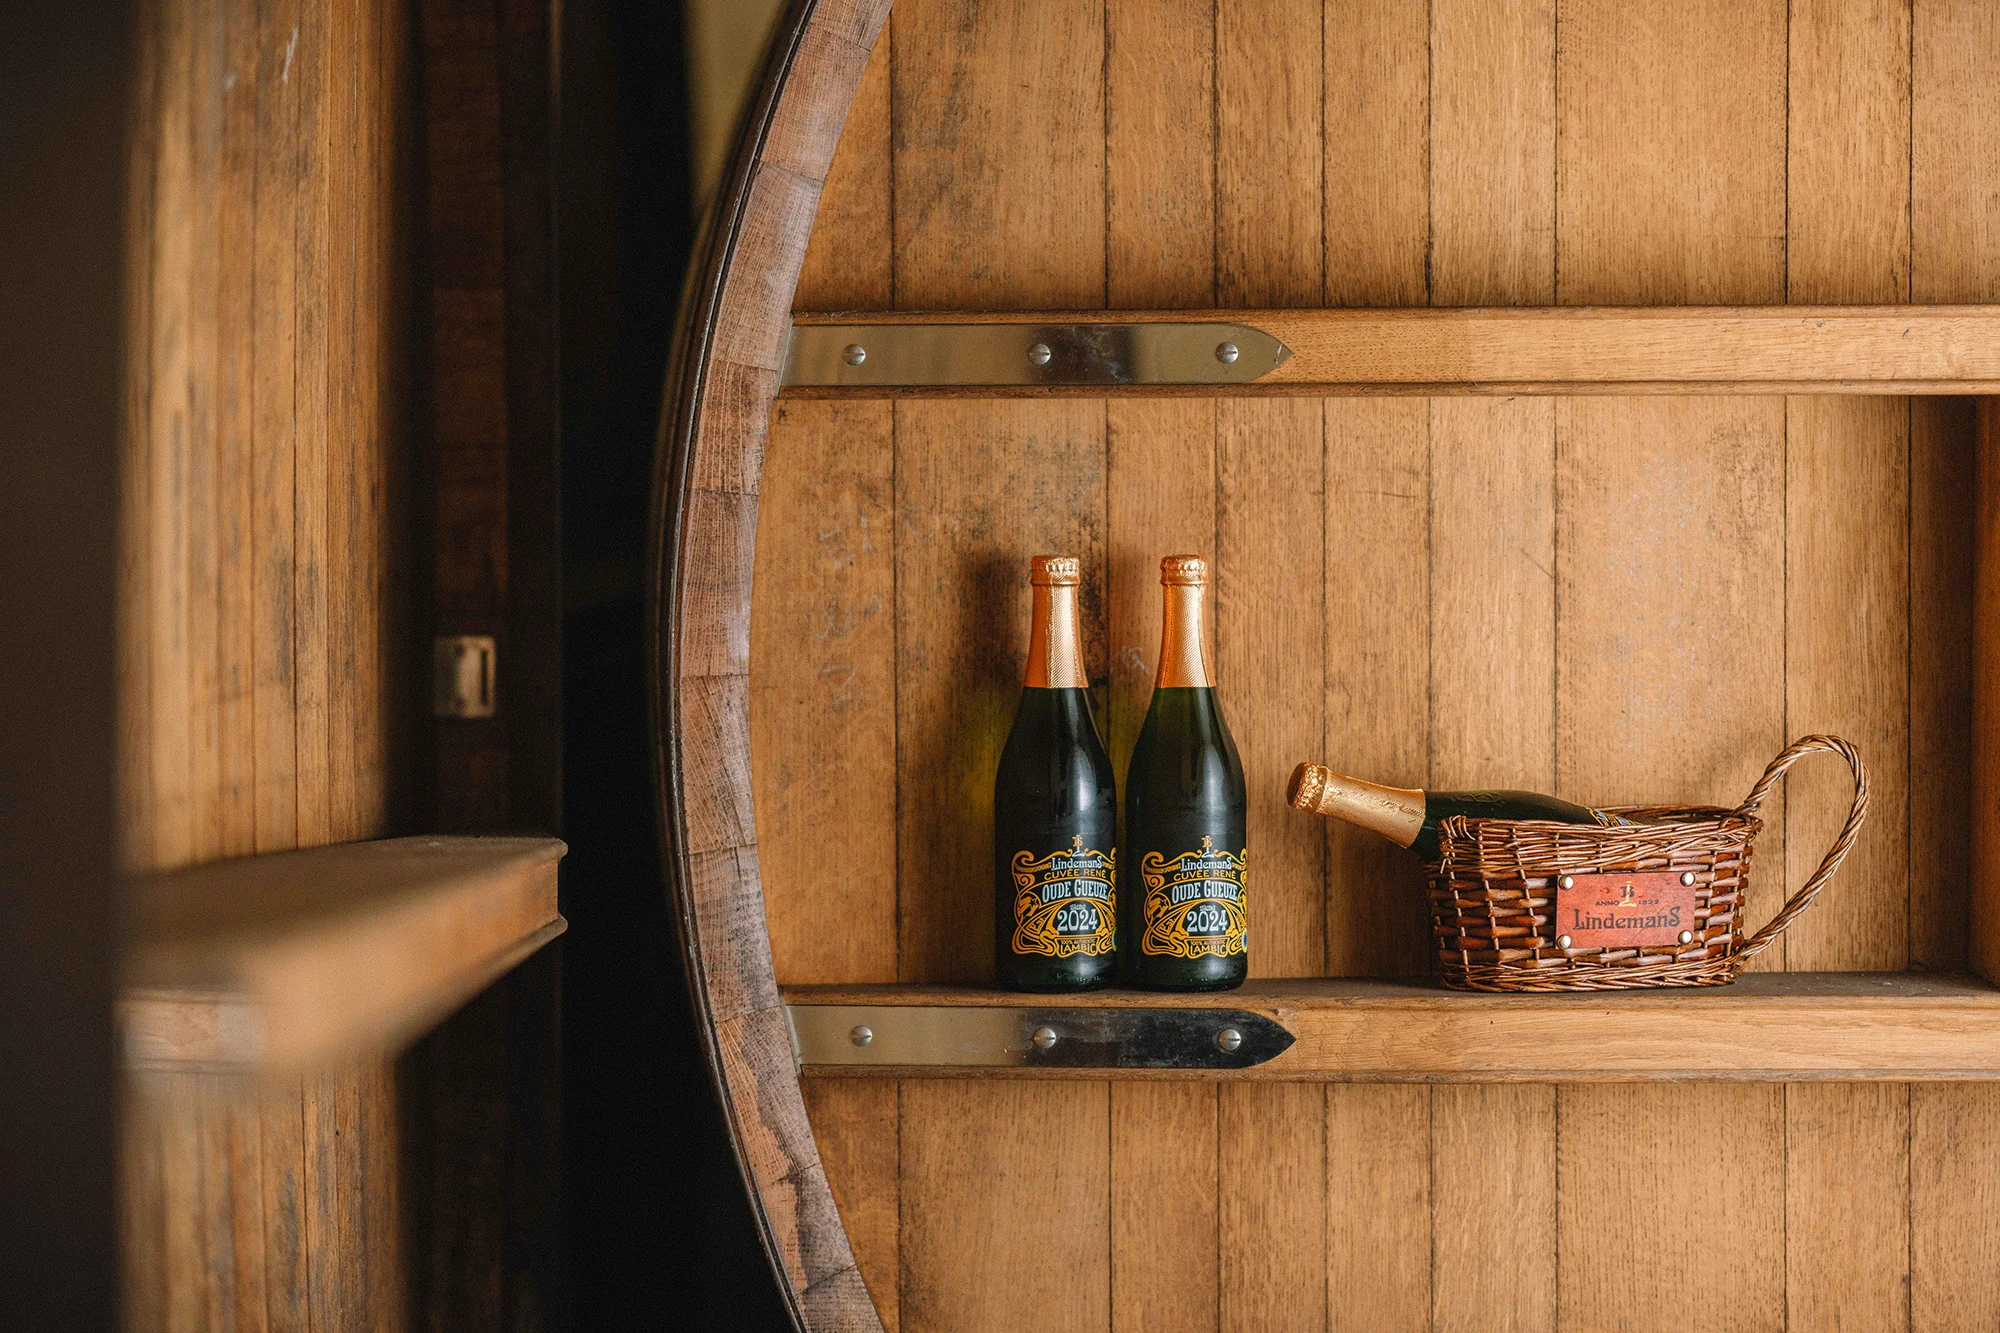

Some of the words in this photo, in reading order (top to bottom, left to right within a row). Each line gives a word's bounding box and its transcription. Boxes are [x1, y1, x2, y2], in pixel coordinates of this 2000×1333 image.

[1044, 869, 1079, 880] CUVÉE
[1084, 869, 1106, 879] RENÉ
[1174, 870, 1209, 881] CUVÉE
[1214, 870, 1236, 880] RENÉ
[1042, 882, 1071, 903] OUDE
[1074, 879, 1108, 900] GUEUZE
[1171, 883, 1200, 904] OUDE
[1204, 880, 1237, 901] GUEUZE
[1057, 909, 1097, 931] 2024
[1187, 910, 1227, 932] 2024
[1060, 943, 1096, 955] LAMBIC
[1190, 944, 1226, 955] LAMBIC
